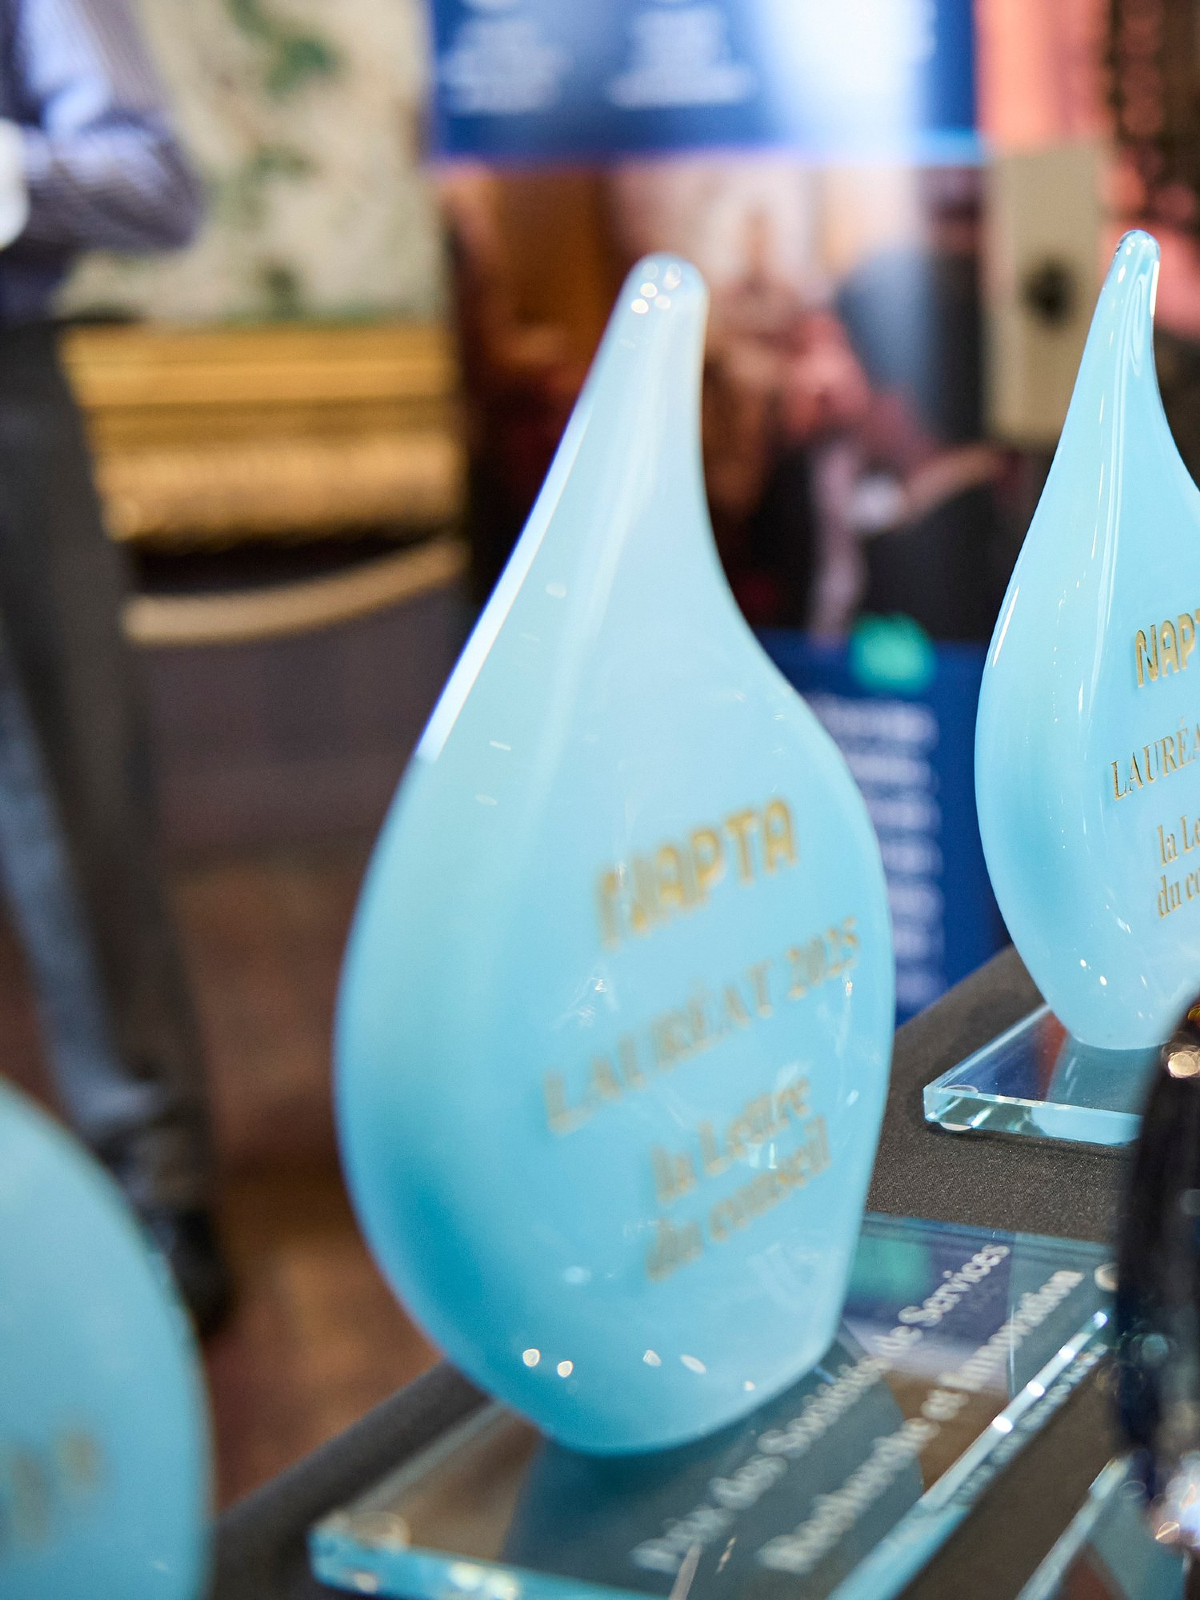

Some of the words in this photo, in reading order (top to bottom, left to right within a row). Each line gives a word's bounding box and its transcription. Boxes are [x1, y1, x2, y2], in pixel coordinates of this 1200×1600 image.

[1157, 823, 1179, 868] la
[1157, 874, 1183, 919] du
[898, 1244, 1011, 1328] Services
